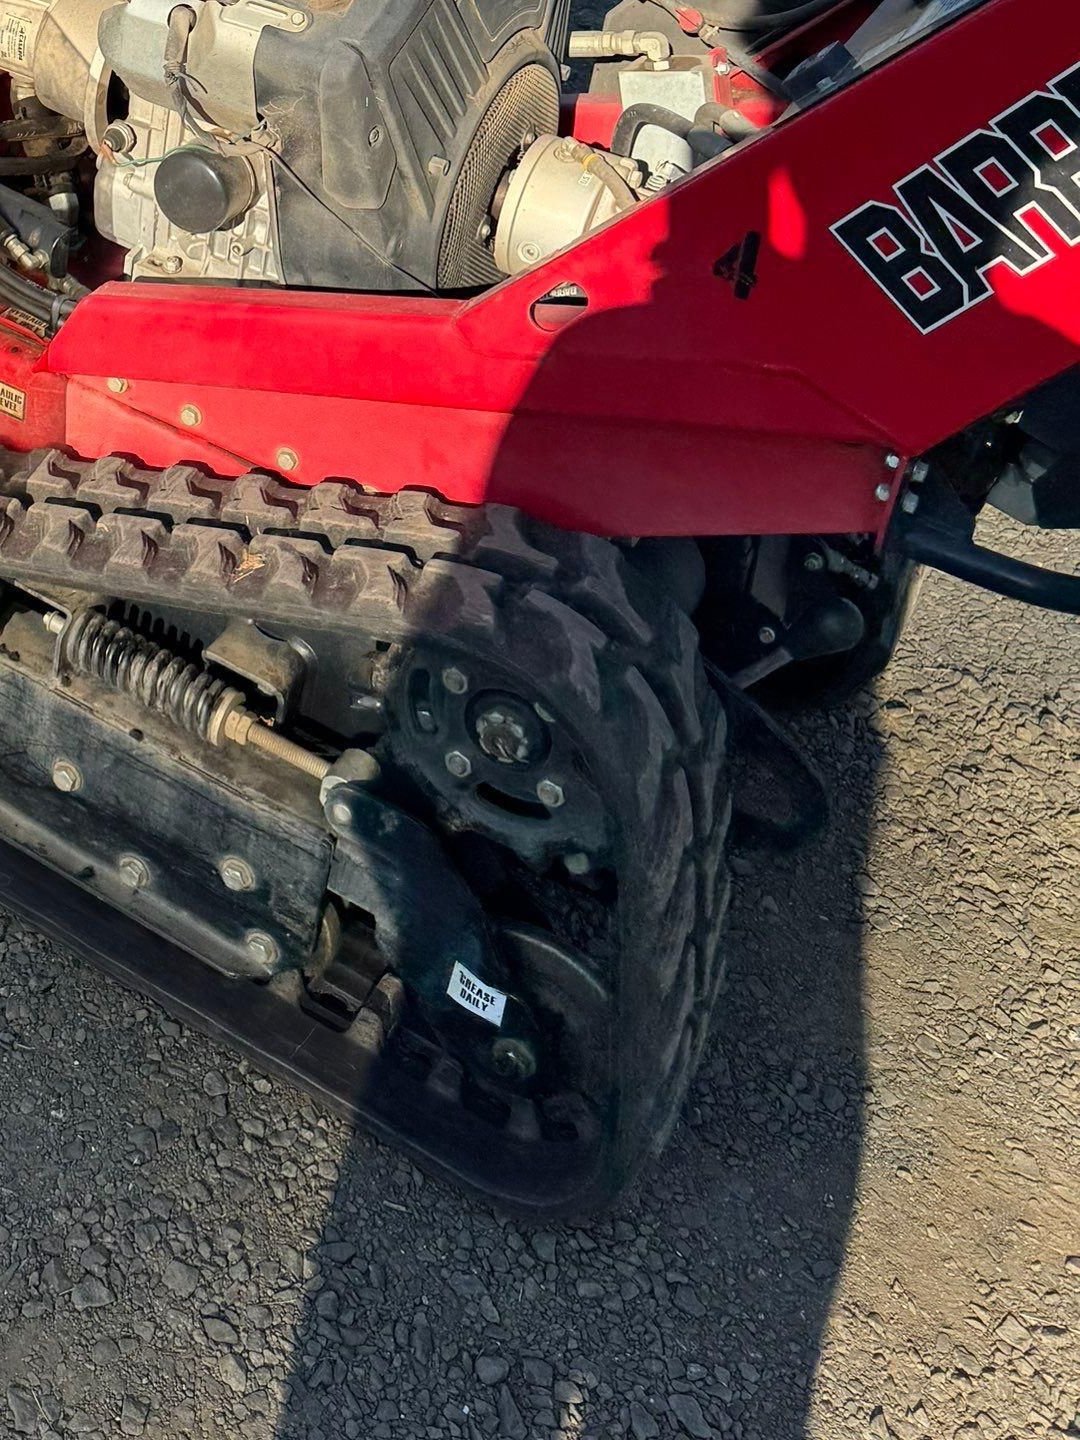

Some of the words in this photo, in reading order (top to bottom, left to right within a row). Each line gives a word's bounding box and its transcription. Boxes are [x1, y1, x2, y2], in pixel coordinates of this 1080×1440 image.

[828, 60, 1080, 335] BARR
[459, 972, 497, 1006] GREASE
[460, 988, 489, 1011] DAILY
